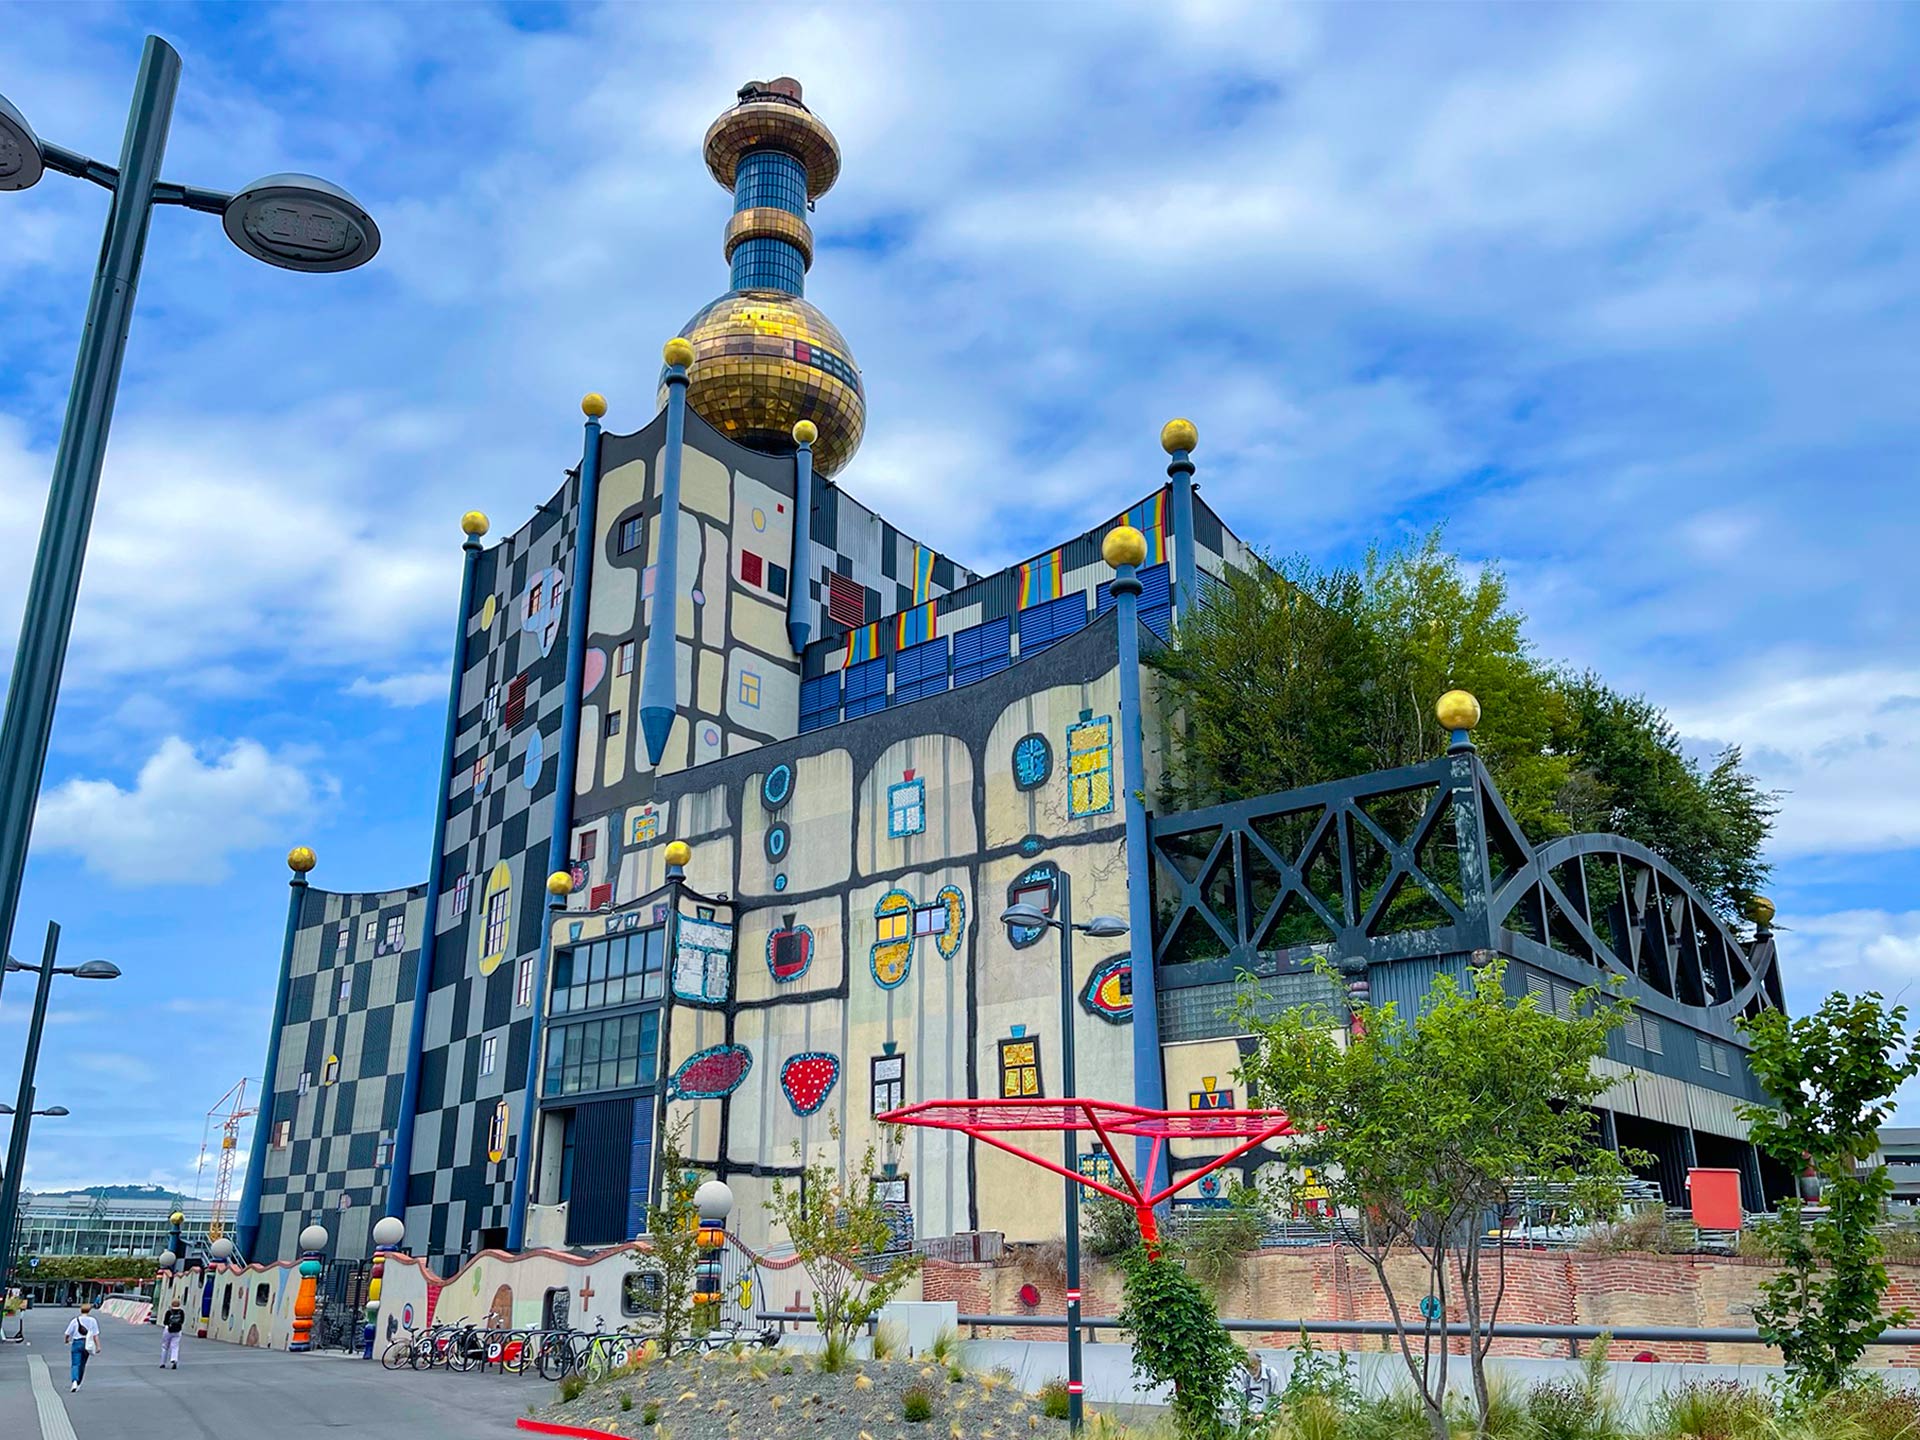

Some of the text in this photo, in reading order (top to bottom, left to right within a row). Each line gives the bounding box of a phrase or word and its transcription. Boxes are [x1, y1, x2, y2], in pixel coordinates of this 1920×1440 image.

[422, 1342, 429, 1351] P
[490, 1345, 498, 1355] P
[616, 1353, 625, 1364] P
